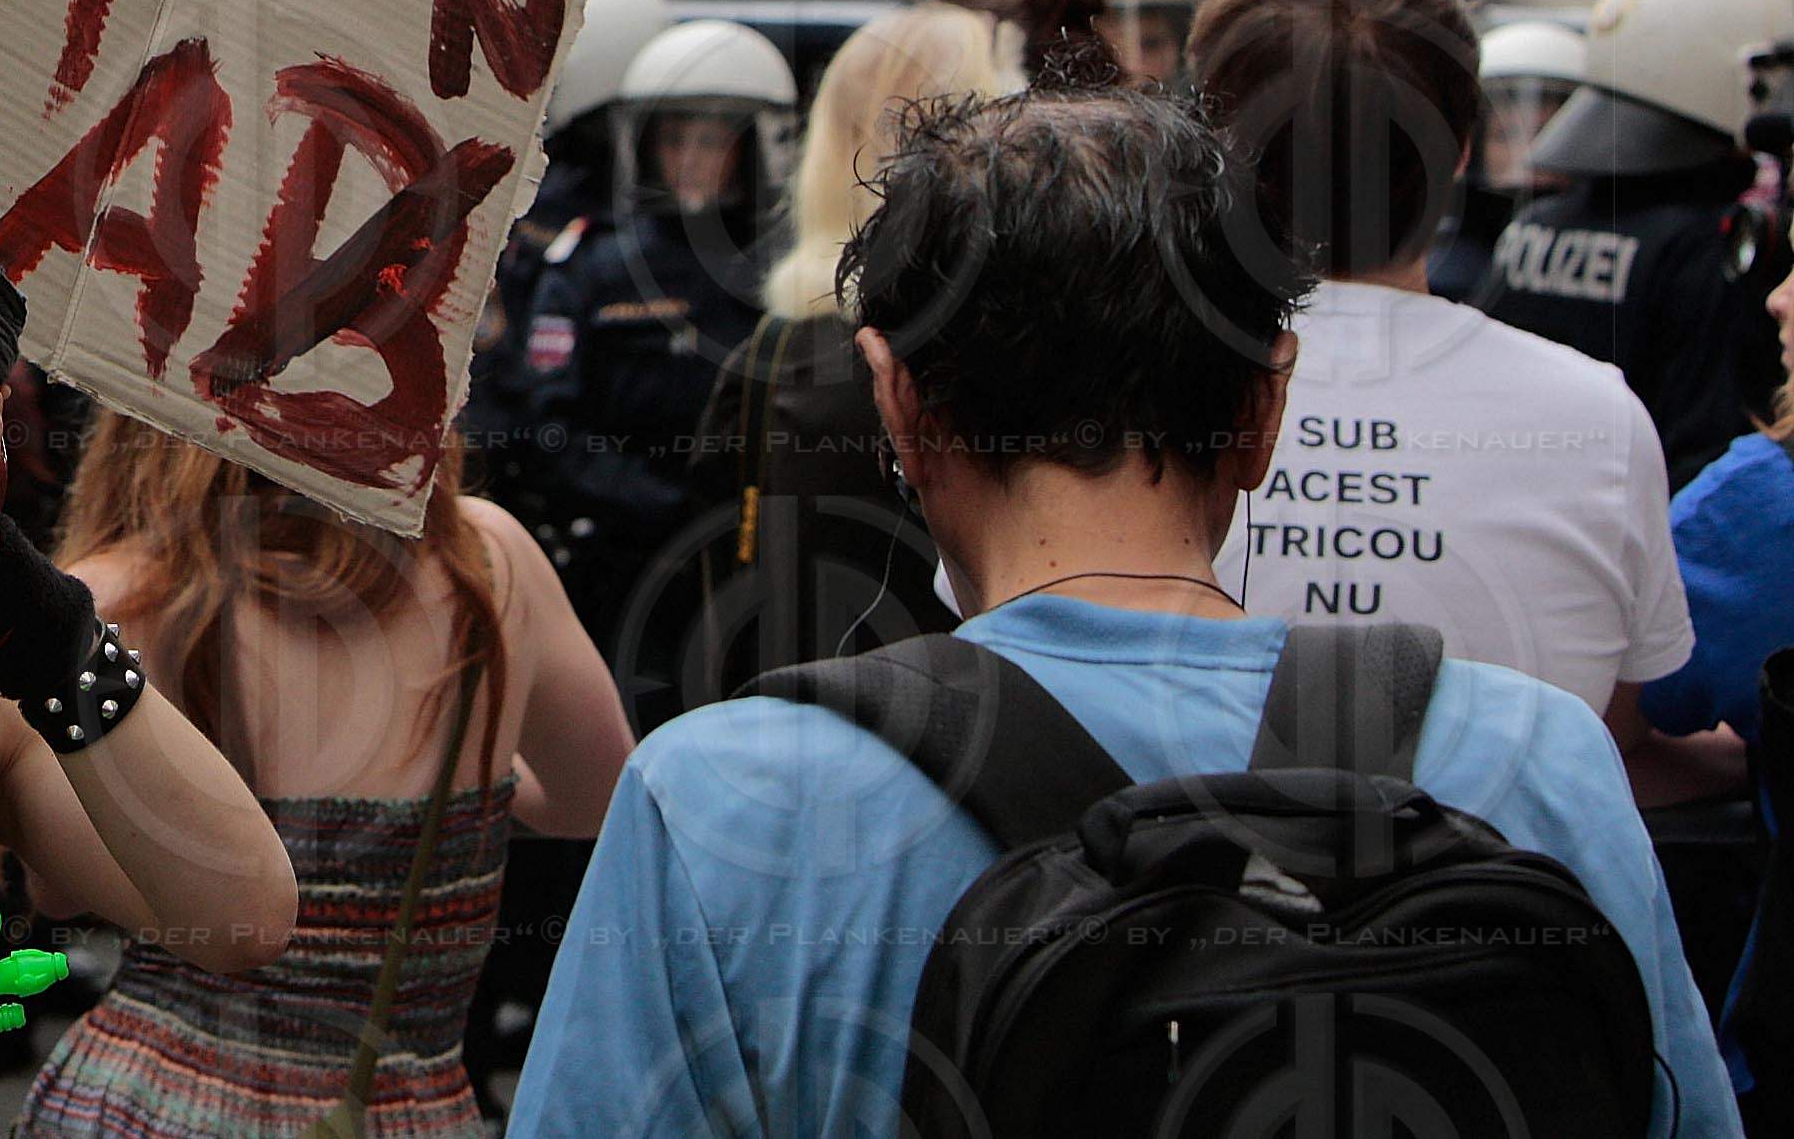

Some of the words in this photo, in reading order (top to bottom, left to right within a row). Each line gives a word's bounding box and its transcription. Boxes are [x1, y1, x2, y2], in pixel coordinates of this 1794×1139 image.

[1492, 219, 1640, 303] POLIZEI
[1298, 416, 1399, 450] SUB
[1264, 469, 1432, 506] ACEST
[1249, 523, 1444, 562] TRICOU
[1305, 582, 1382, 615] NU
